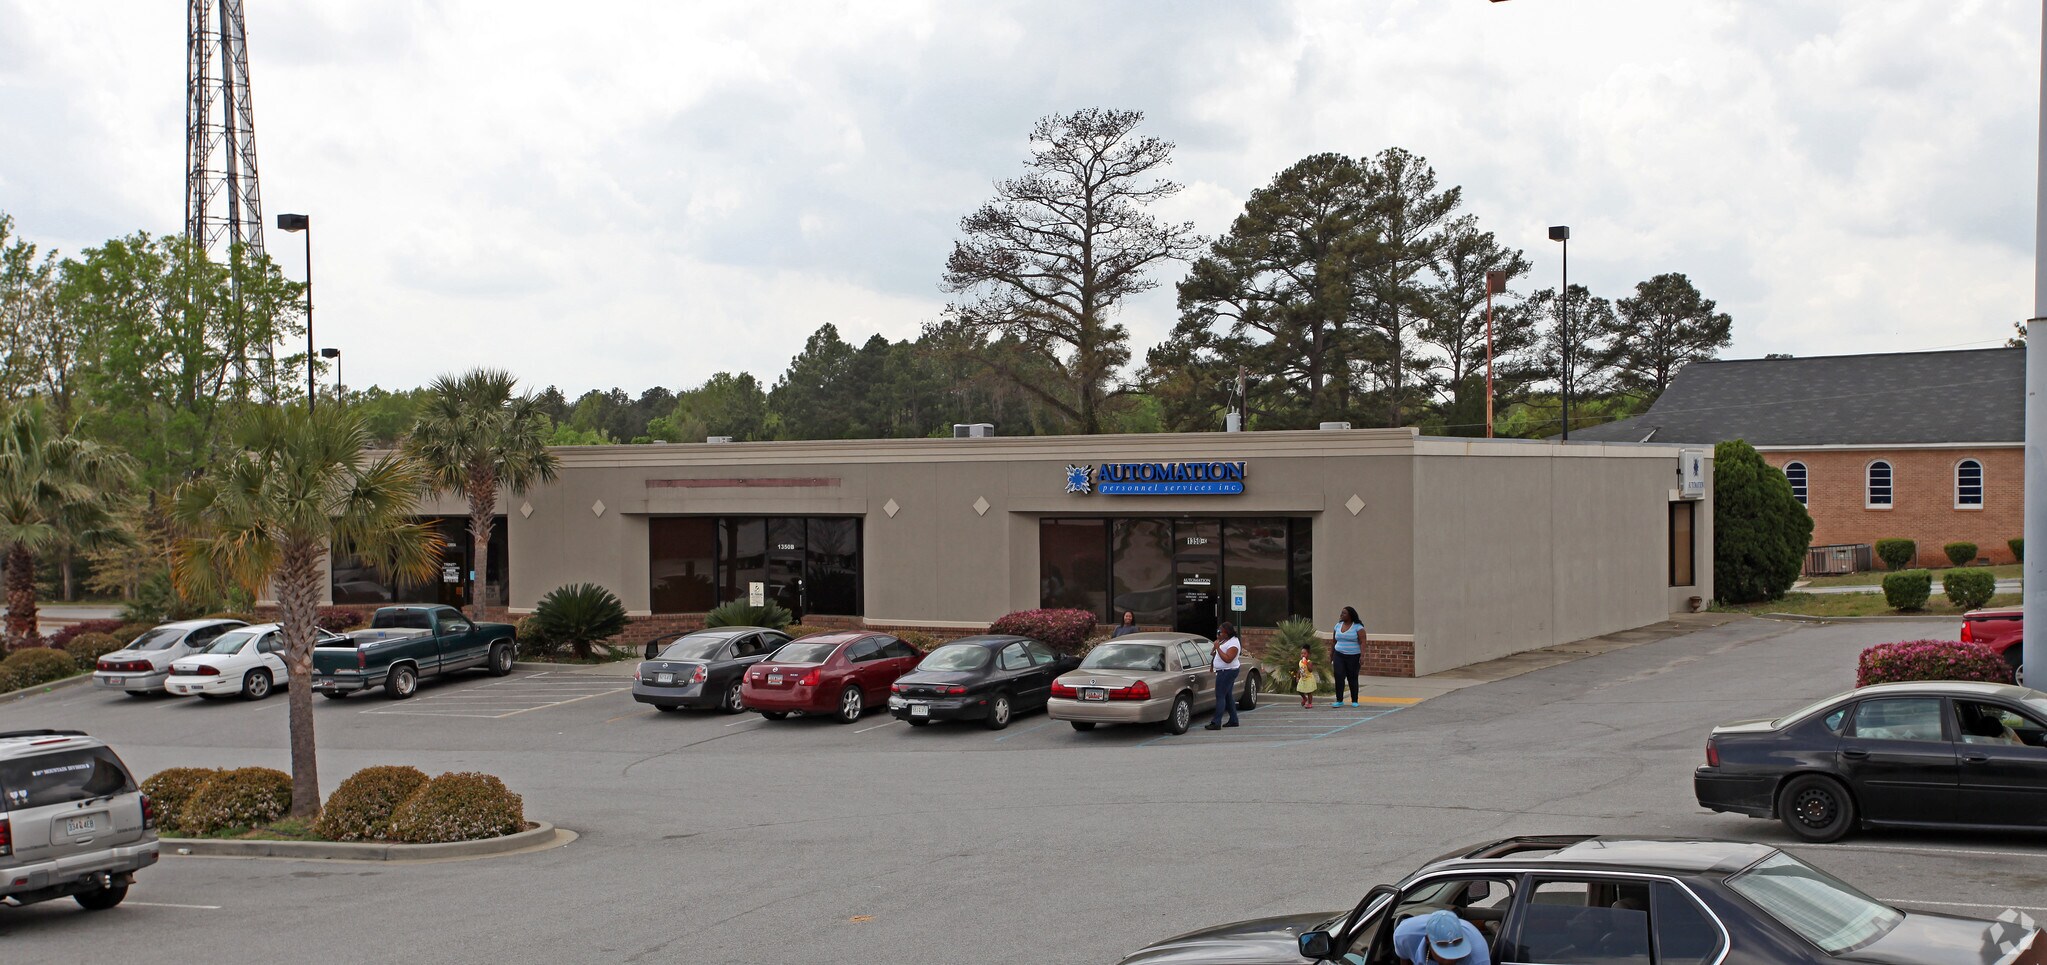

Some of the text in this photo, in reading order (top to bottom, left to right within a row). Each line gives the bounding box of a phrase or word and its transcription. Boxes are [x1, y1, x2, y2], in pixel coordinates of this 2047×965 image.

[1097, 462, 1246, 481] AUTOMATION
[1102, 482, 1240, 492] personnel services inc.
